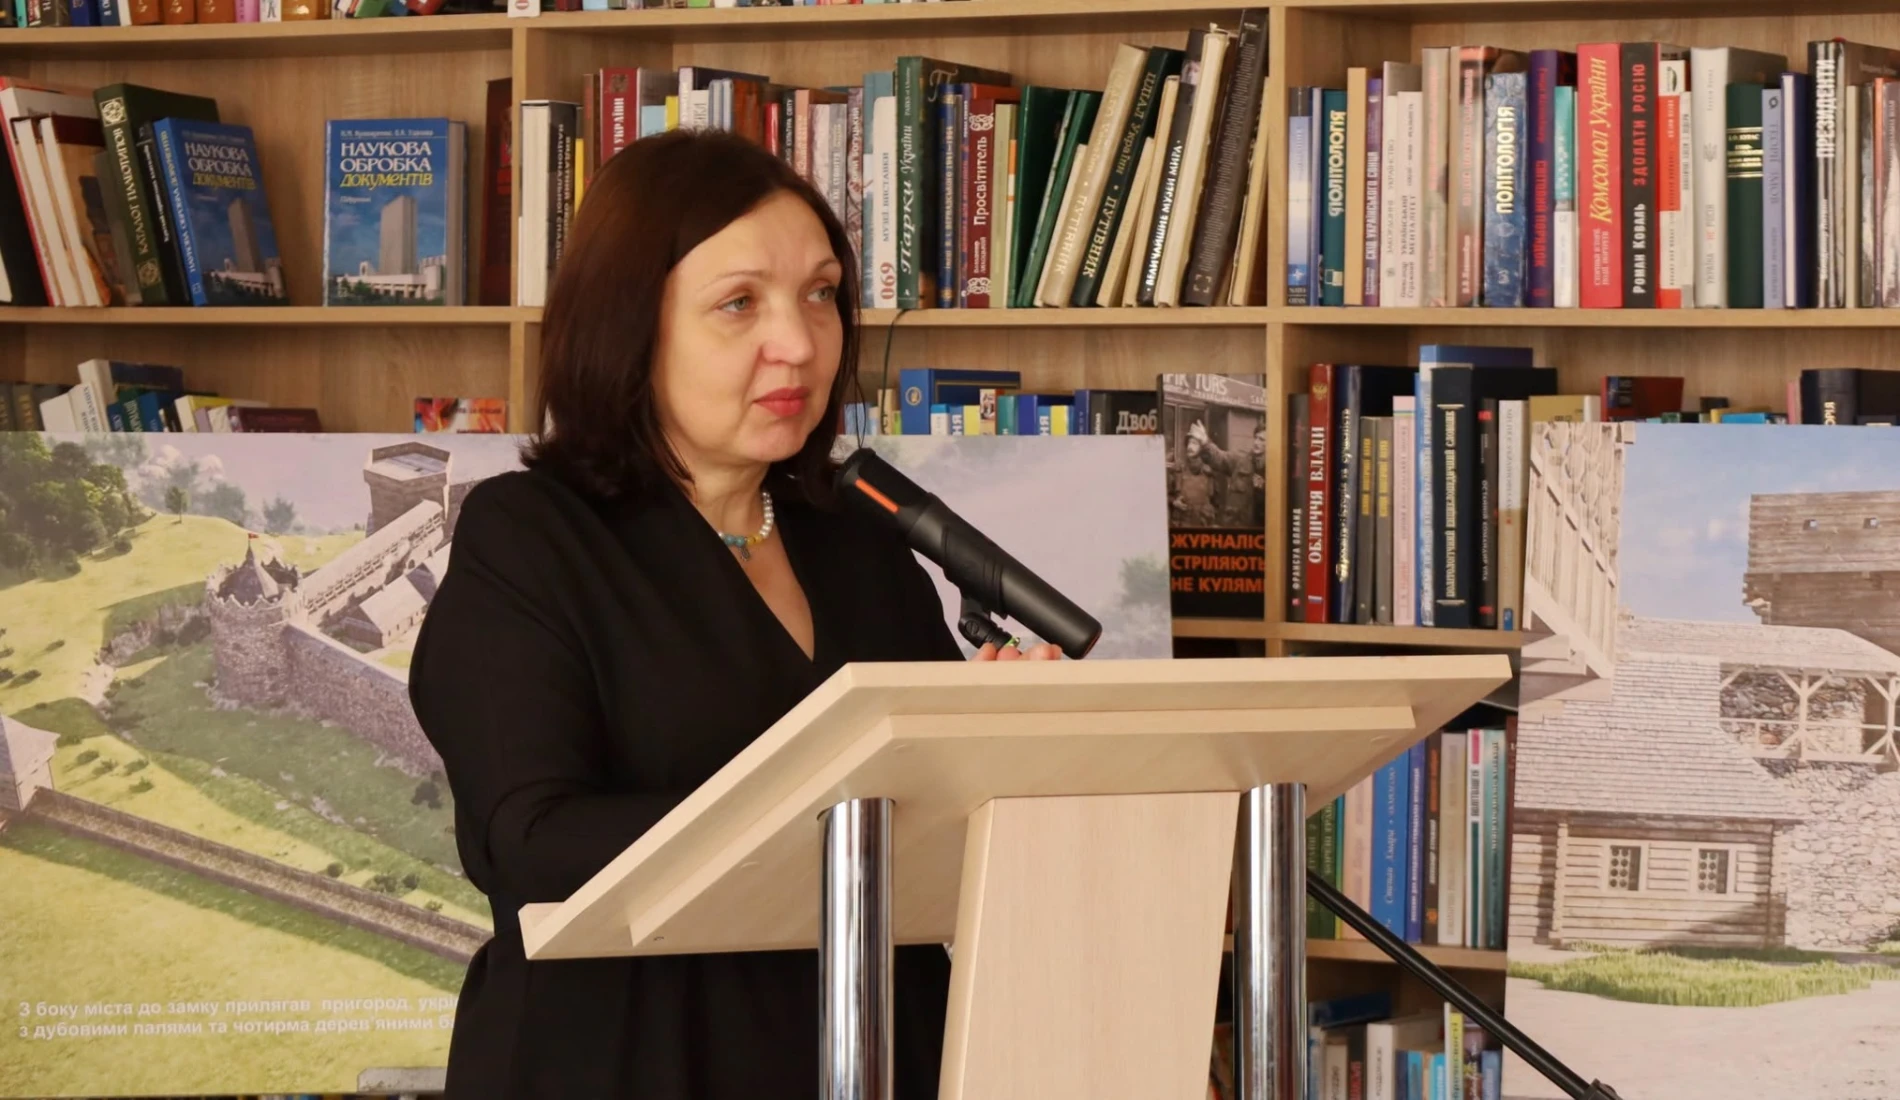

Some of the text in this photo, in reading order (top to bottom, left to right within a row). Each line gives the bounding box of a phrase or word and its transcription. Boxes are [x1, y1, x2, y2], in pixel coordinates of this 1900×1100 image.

[611, 97, 625, 144] УКРАЇНИ
[1632, 63, 1648, 186] ЗДОЛАТИ РОСІЮ
[1816, 59, 1836, 158] ПРЕЗИДЕНТИ
[184, 141, 249, 162] НАУКОВА
[188, 157, 253, 176] ОБРОБКА
[340, 157, 432, 172] ОБРОБКА
[341, 141, 432, 157] НАУКОВА
[1115, 123, 1143, 175] України
[1328, 109, 1346, 217] ПОЛІТОЛОГІЯ
[1366, 151, 1379, 178] СОНЦЯ
[1386, 139, 1394, 190] УКРАЇНСТВО
[1496, 106, 1514, 214] ПОЛІТОЛОГІЯ
[1587, 55, 1613, 223] Комсомол України
[556, 124, 564, 214] НАЦІОНАЛЬНОЇ
[972, 137, 989, 227] Просвітитель
[899, 124, 915, 276] Парки України
[1146, 145, 1183, 286] ВЕЛИЧАЙШИЕ МУЗЕИ МИРА
[1366, 180, 1379, 238] УКРАЇНСЬКОГО
[1400, 195, 1408, 255] УКРАЇНСЬКИЙ
[1408, 195, 1416, 255] МЕНТАЛІТЕТ
[1534, 160, 1548, 268] СВІТОВИЙ ПОРЯДОК
[130, 204, 149, 254] КАТАЛОГ
[182, 230, 196, 273] НАУКОВА
[1055, 194, 1089, 277] ПУТІВНИК
[1082, 196, 1118, 278] ПУТІВНИК
[1366, 240, 1378, 260] СХІД
[880, 261, 896, 300] 069
[1704, 253, 1715, 284] УКРАЇНА
[1307, 426, 1325, 564] ОБЛИЧЧЯ ВЛАДИ
[1444, 410, 1457, 598] ПОЛІТОЛОГІЧНИЙ ЕНЦИКЛОПЕДИЧНИЙ СЛОВНИК
[1481, 479, 1490, 519] ОСТАННІЙ
[1292, 508, 1302, 590] ФРАНСУА ОЛЛАНД
[1481, 521, 1489, 564] КОМАНДИР
[1171, 576, 1264, 592] НЕ КУЛЯМ
[33, 1022, 128, 1041] дубовими
[133, 1021, 202, 1035] палями
[208, 1021, 228, 1033] та
[233, 1020, 310, 1036] чотирма
[36, 1001, 78, 1018] боку
[84, 1000, 132, 1015] міста
[137, 1002, 162, 1016] до
[168, 1000, 220, 1017] замку
[225, 1000, 311, 1017] прилягав
